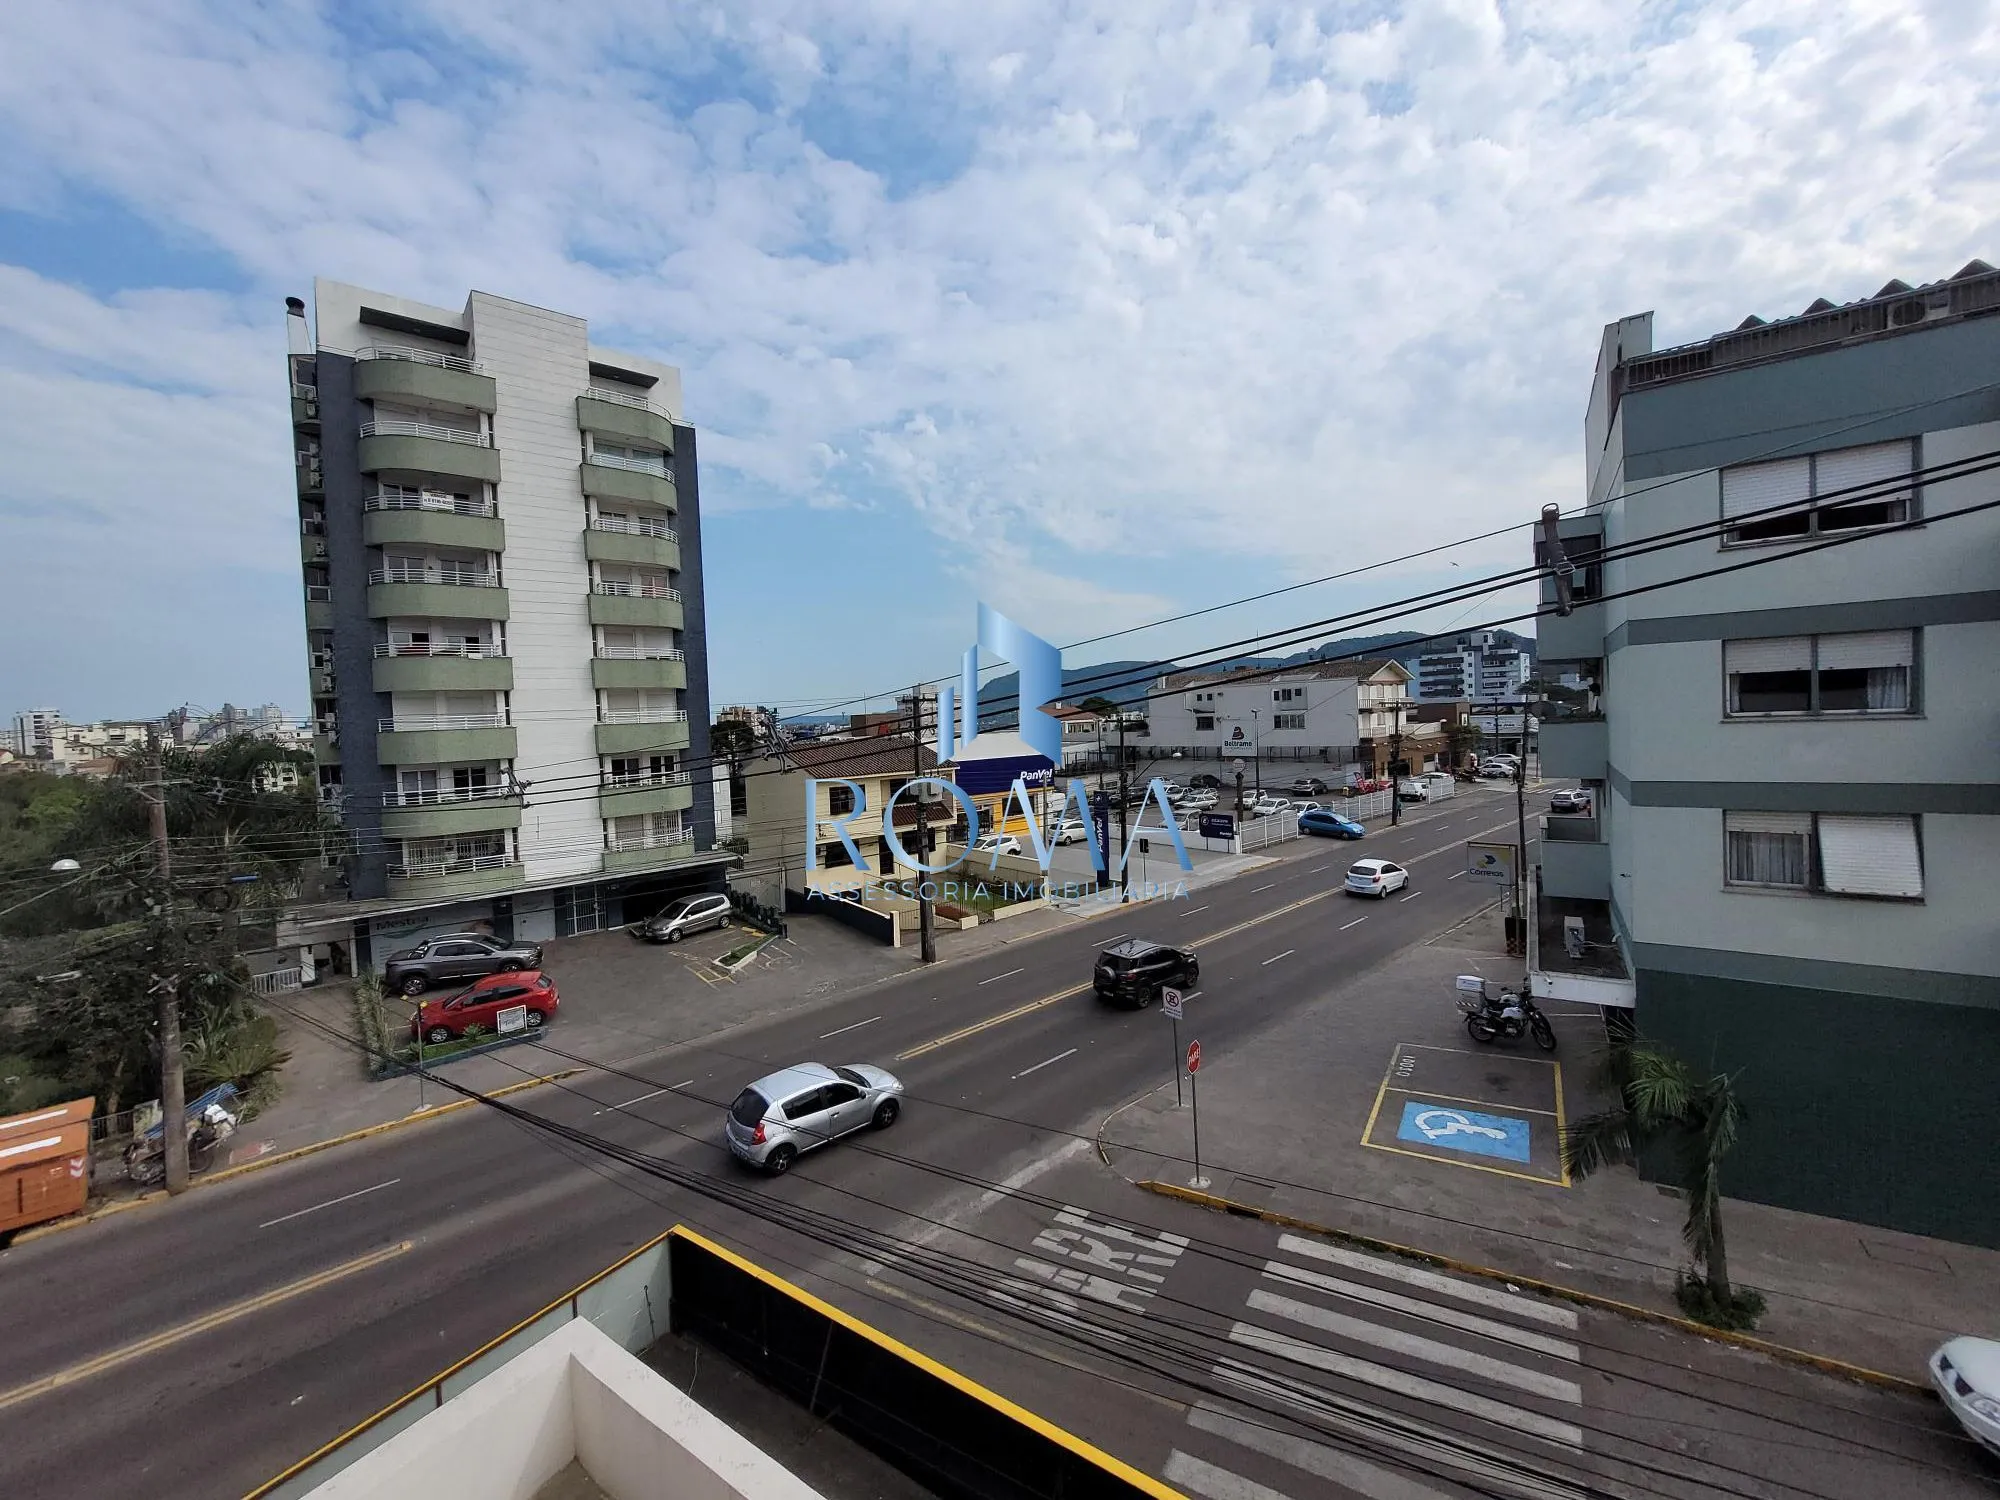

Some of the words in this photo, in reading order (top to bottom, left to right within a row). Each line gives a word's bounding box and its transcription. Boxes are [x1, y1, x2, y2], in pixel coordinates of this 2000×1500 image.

[1469, 868, 1505, 878] Correios
[1188, 1048, 1200, 1066] PARE
[985, 1205, 1191, 1342] PARE
